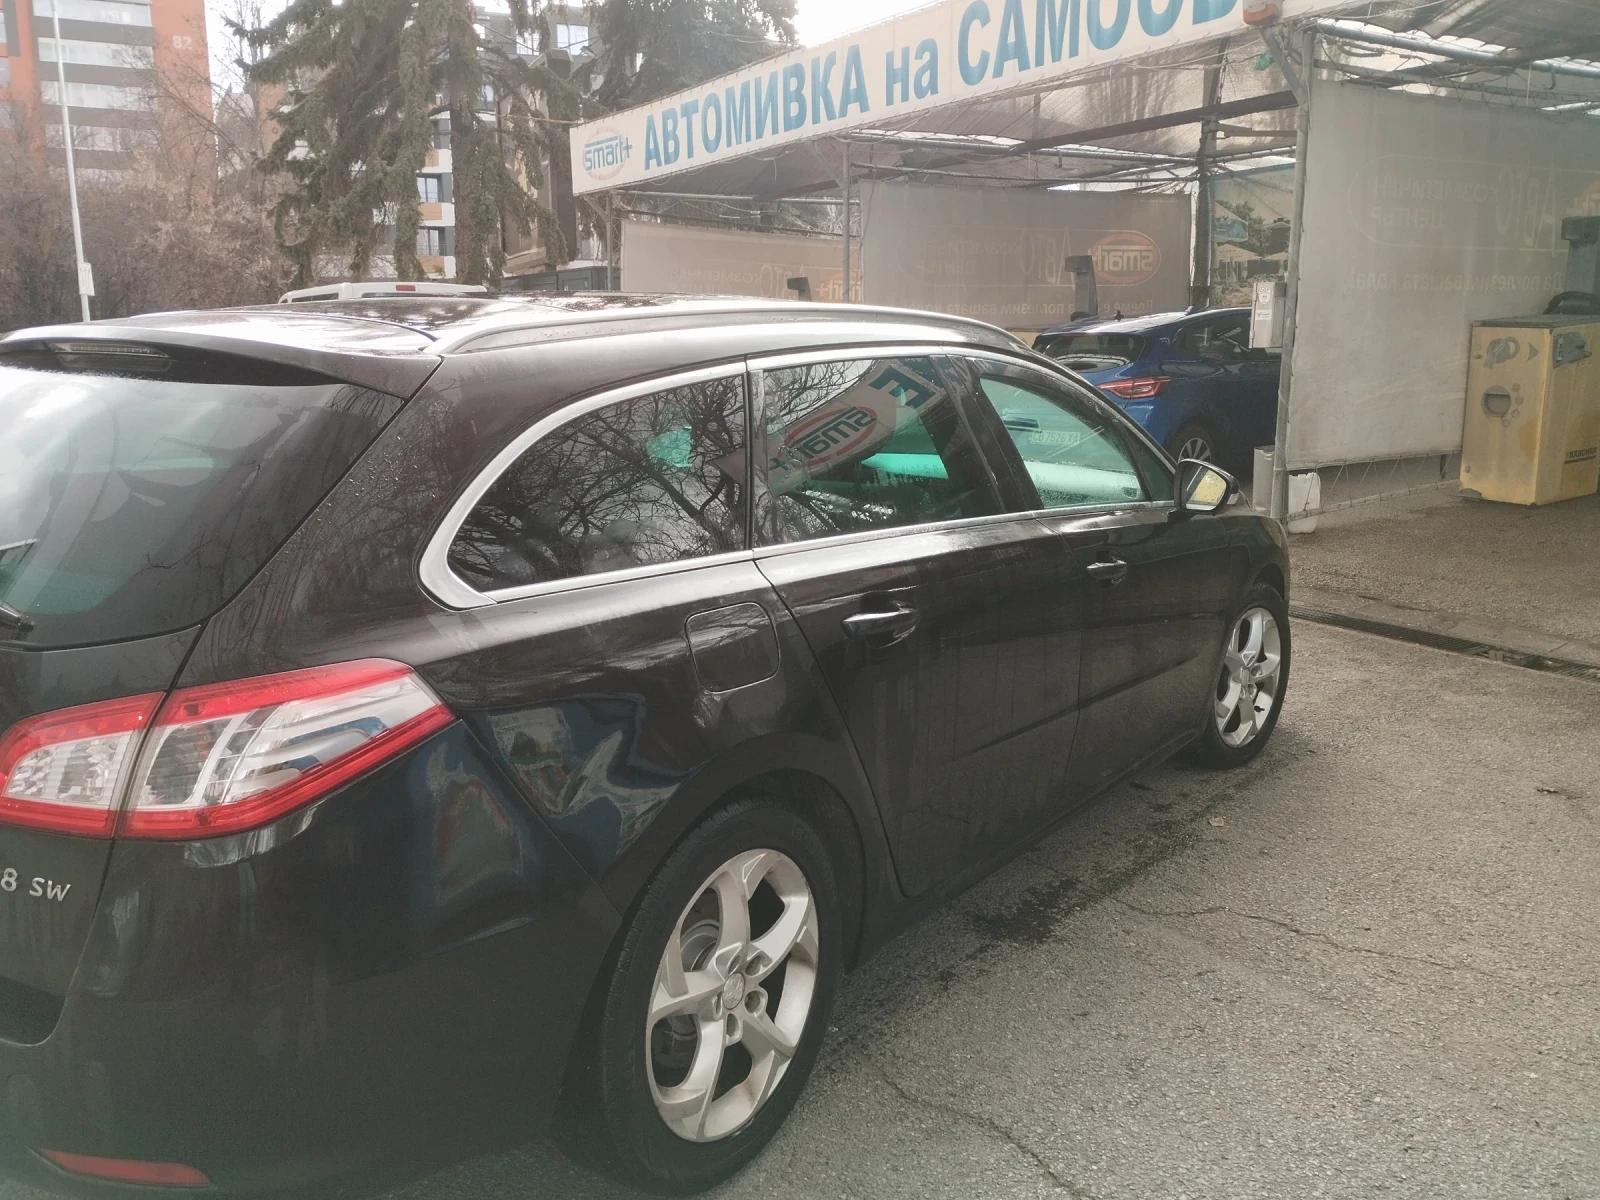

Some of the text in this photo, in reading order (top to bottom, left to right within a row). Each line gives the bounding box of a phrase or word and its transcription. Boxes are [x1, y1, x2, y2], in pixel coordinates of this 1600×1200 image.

[172, 35, 192, 50] 82
[644, 0, 1238, 171] АВТОМИВКА на САМО
[29, 877, 72, 902] SW
